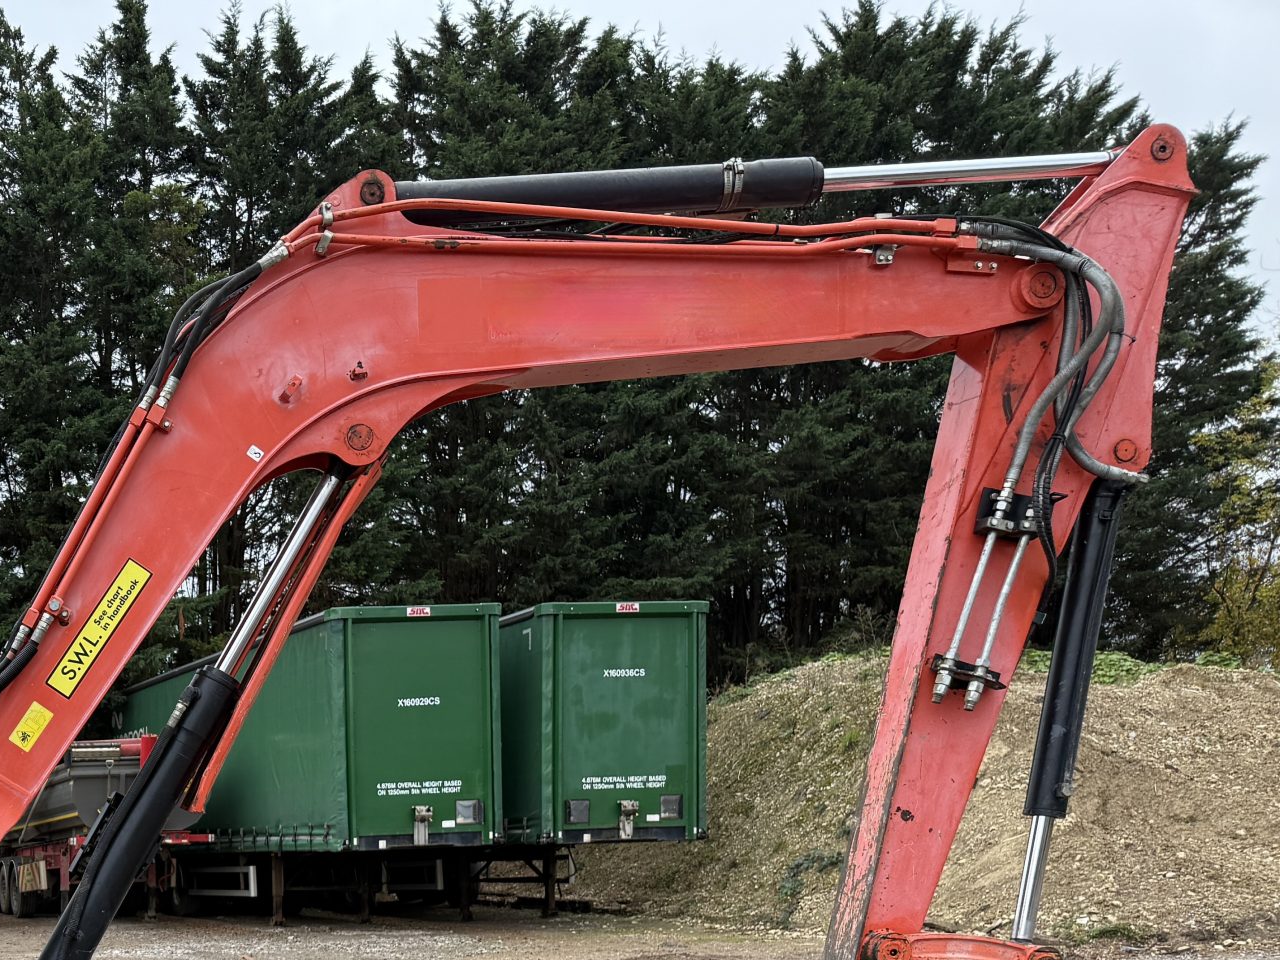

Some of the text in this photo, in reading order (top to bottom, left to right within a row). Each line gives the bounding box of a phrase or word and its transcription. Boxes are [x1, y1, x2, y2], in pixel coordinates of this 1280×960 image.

[94, 586, 124, 626] See chart
[100, 579, 139, 631] in handbook
[61, 636, 102, 681] S.W.L.
